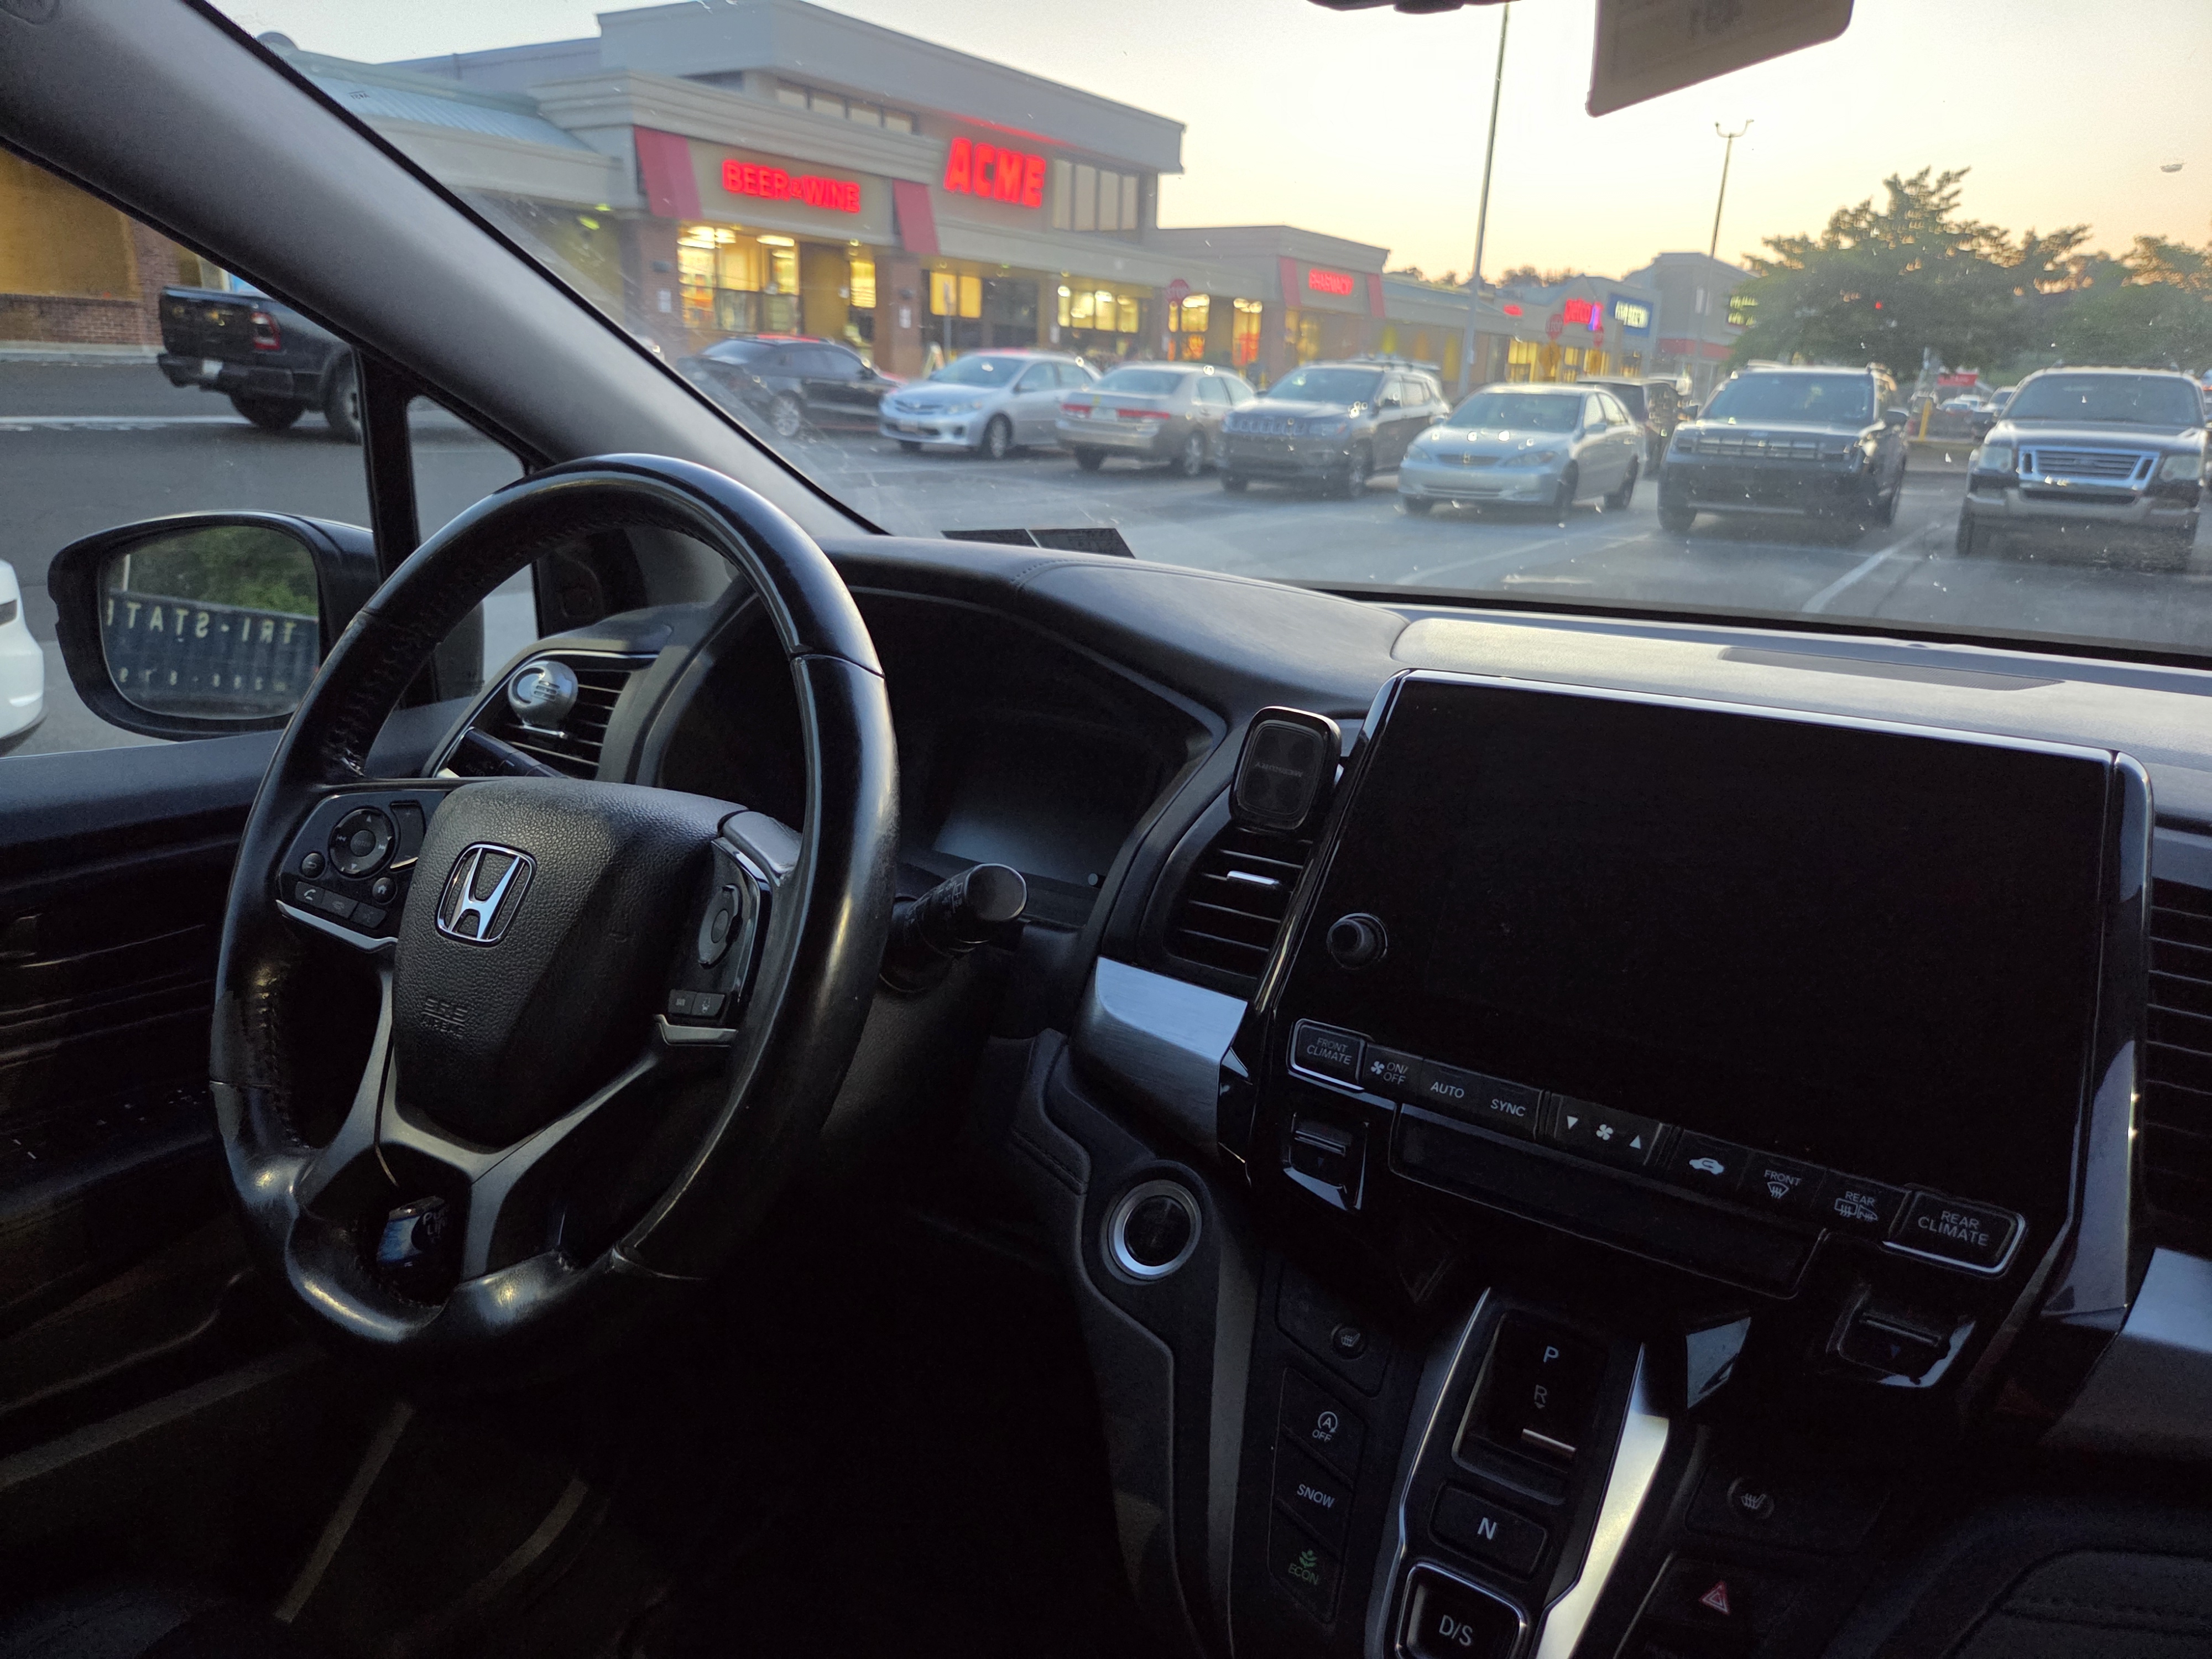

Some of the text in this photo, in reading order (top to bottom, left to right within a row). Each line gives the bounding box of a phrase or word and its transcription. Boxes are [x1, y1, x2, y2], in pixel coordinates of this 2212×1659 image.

[944, 137, 1046, 209] ACME
[723, 160, 790, 201] BEER
[801, 175, 860, 213] WINE
[1306, 1044, 1353, 1065] CLIMATE
[1316, 1037, 1349, 1053] FRONT
[1386, 1062, 1408, 1074] ON/
[1383, 1072, 1407, 1085] OFF
[1430, 1081, 1465, 1099] AUTO
[1490, 1098, 1526, 1117] SYNC
[1764, 1169, 1802, 1186] FRONT
[1845, 1191, 1875, 1207] REAR
[1940, 1210, 1980, 1230] REAR
[1918, 1216, 1990, 1246] CLIMATE
[1542, 1345, 1560, 1364] P
[1533, 1384, 1548, 1404] R
[1322, 1417, 1332, 1429] A
[1312, 1429, 1332, 1442] OFF
[1297, 1483, 1335, 1509] SNOW
[1477, 1517, 1497, 1540] N
[1287, 1563, 1319, 1586] ECON
[1438, 1614, 1474, 1647] D/S
